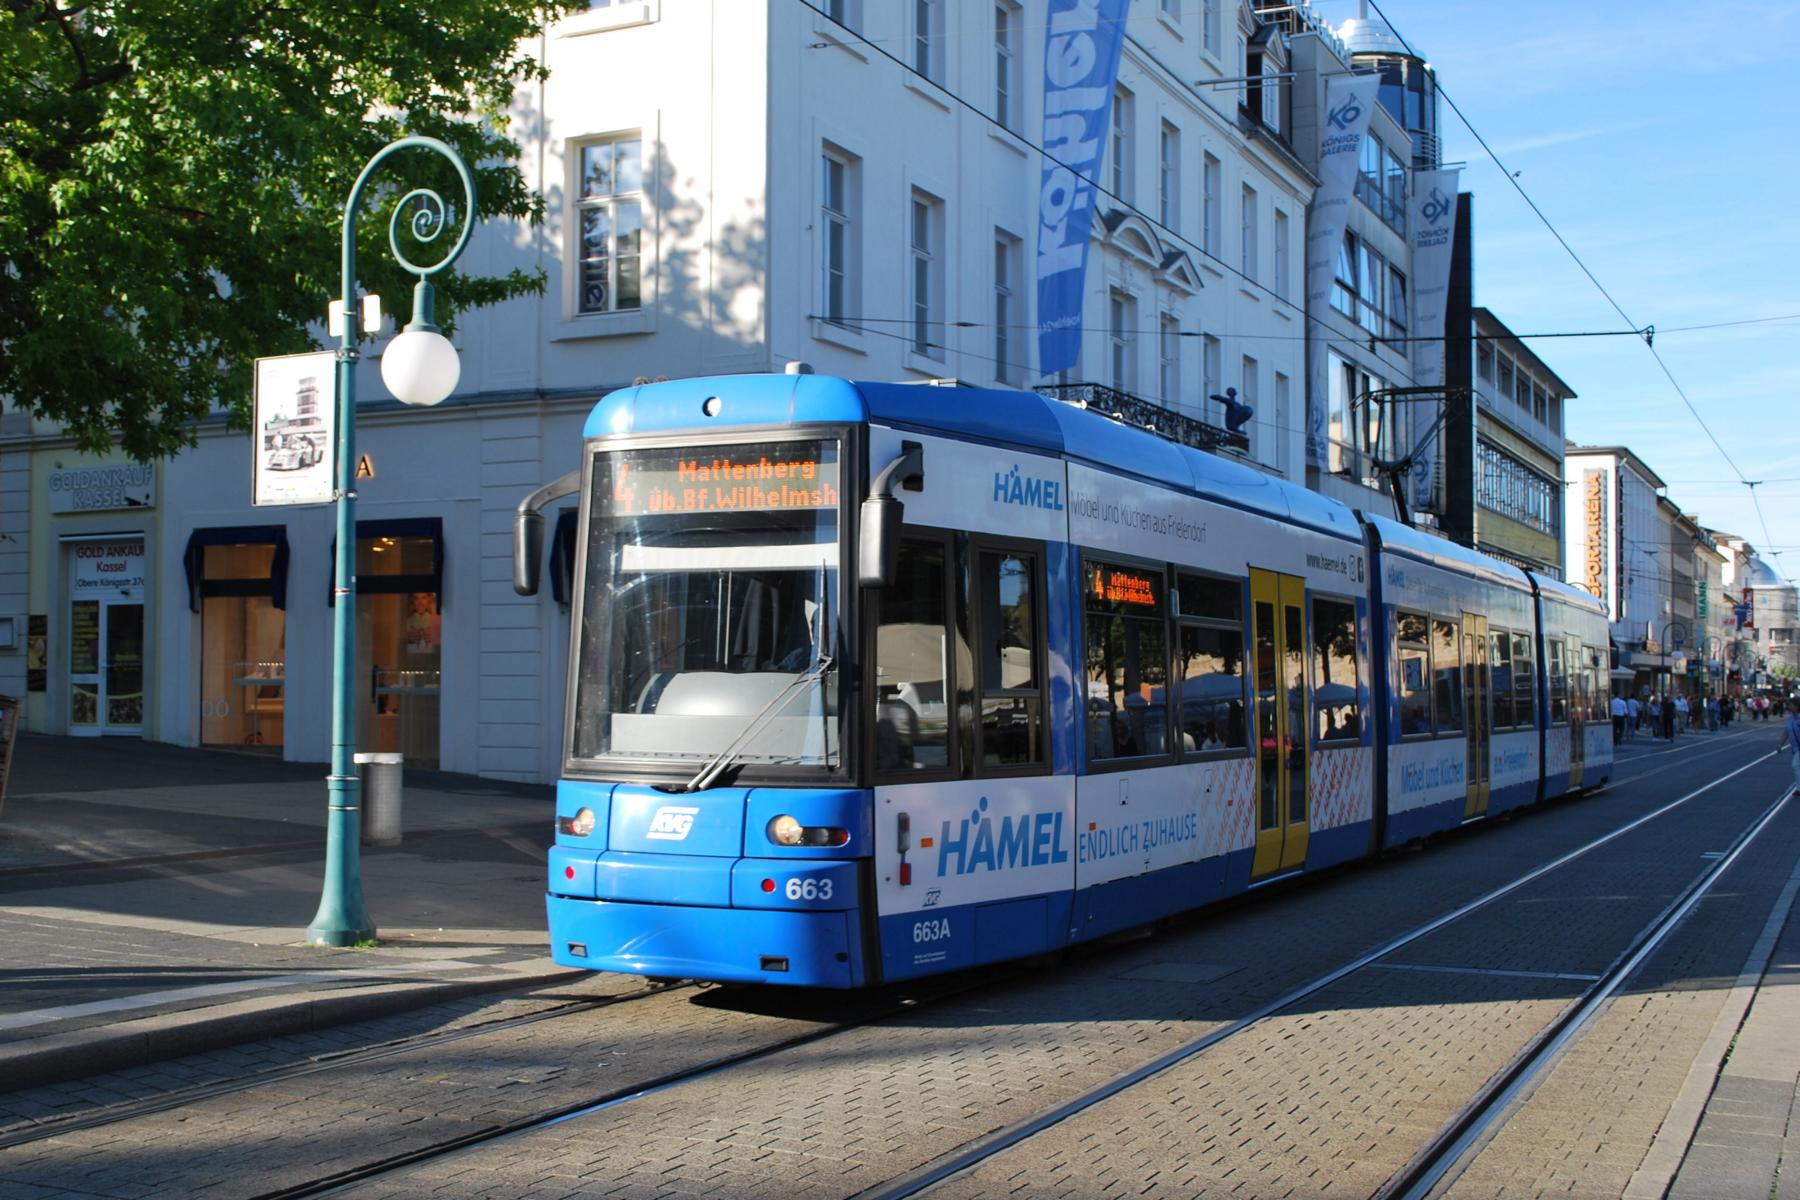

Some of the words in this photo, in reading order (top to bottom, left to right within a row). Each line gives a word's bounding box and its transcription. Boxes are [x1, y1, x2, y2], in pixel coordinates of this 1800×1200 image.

[678, 457, 815, 482] Mattenberg
[993, 464, 1063, 511] HÄMEL
[937, 797, 1068, 877] HÄMEL
[1079, 824, 1138, 864] ENDLICH
[1142, 813, 1197, 850] ZUHAUSE
[785, 878, 833, 900] 663
[913, 918, 951, 943] 663A
